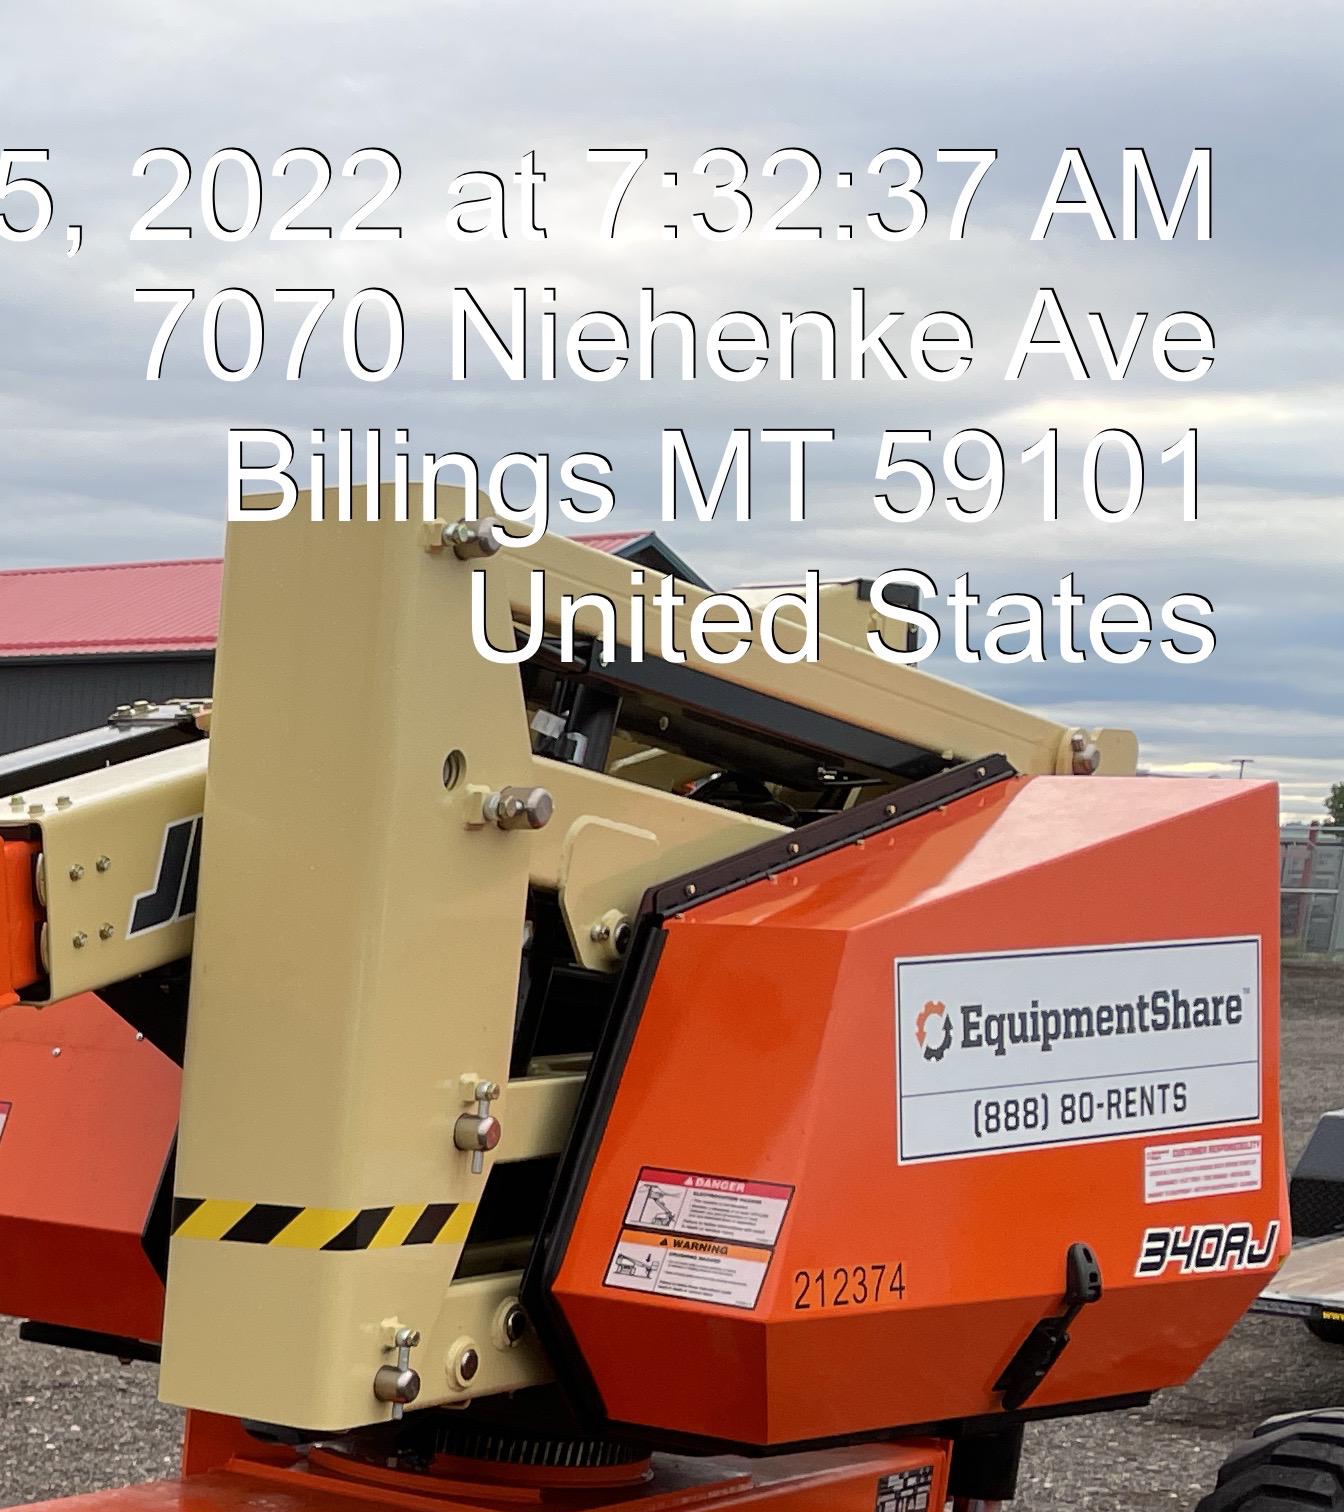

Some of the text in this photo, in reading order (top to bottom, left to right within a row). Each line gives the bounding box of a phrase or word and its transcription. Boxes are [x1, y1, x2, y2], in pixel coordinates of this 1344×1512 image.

[960, 988, 1243, 1056] EquipmentShare
[973, 1080, 1188, 1138] (888) 80-RENTS
[694, 1177, 746, 1193] DANGER
[672, 1238, 729, 1256] WARNING
[1135, 1220, 1280, 1279] 340AJ
[793, 1261, 907, 1310] 212374
